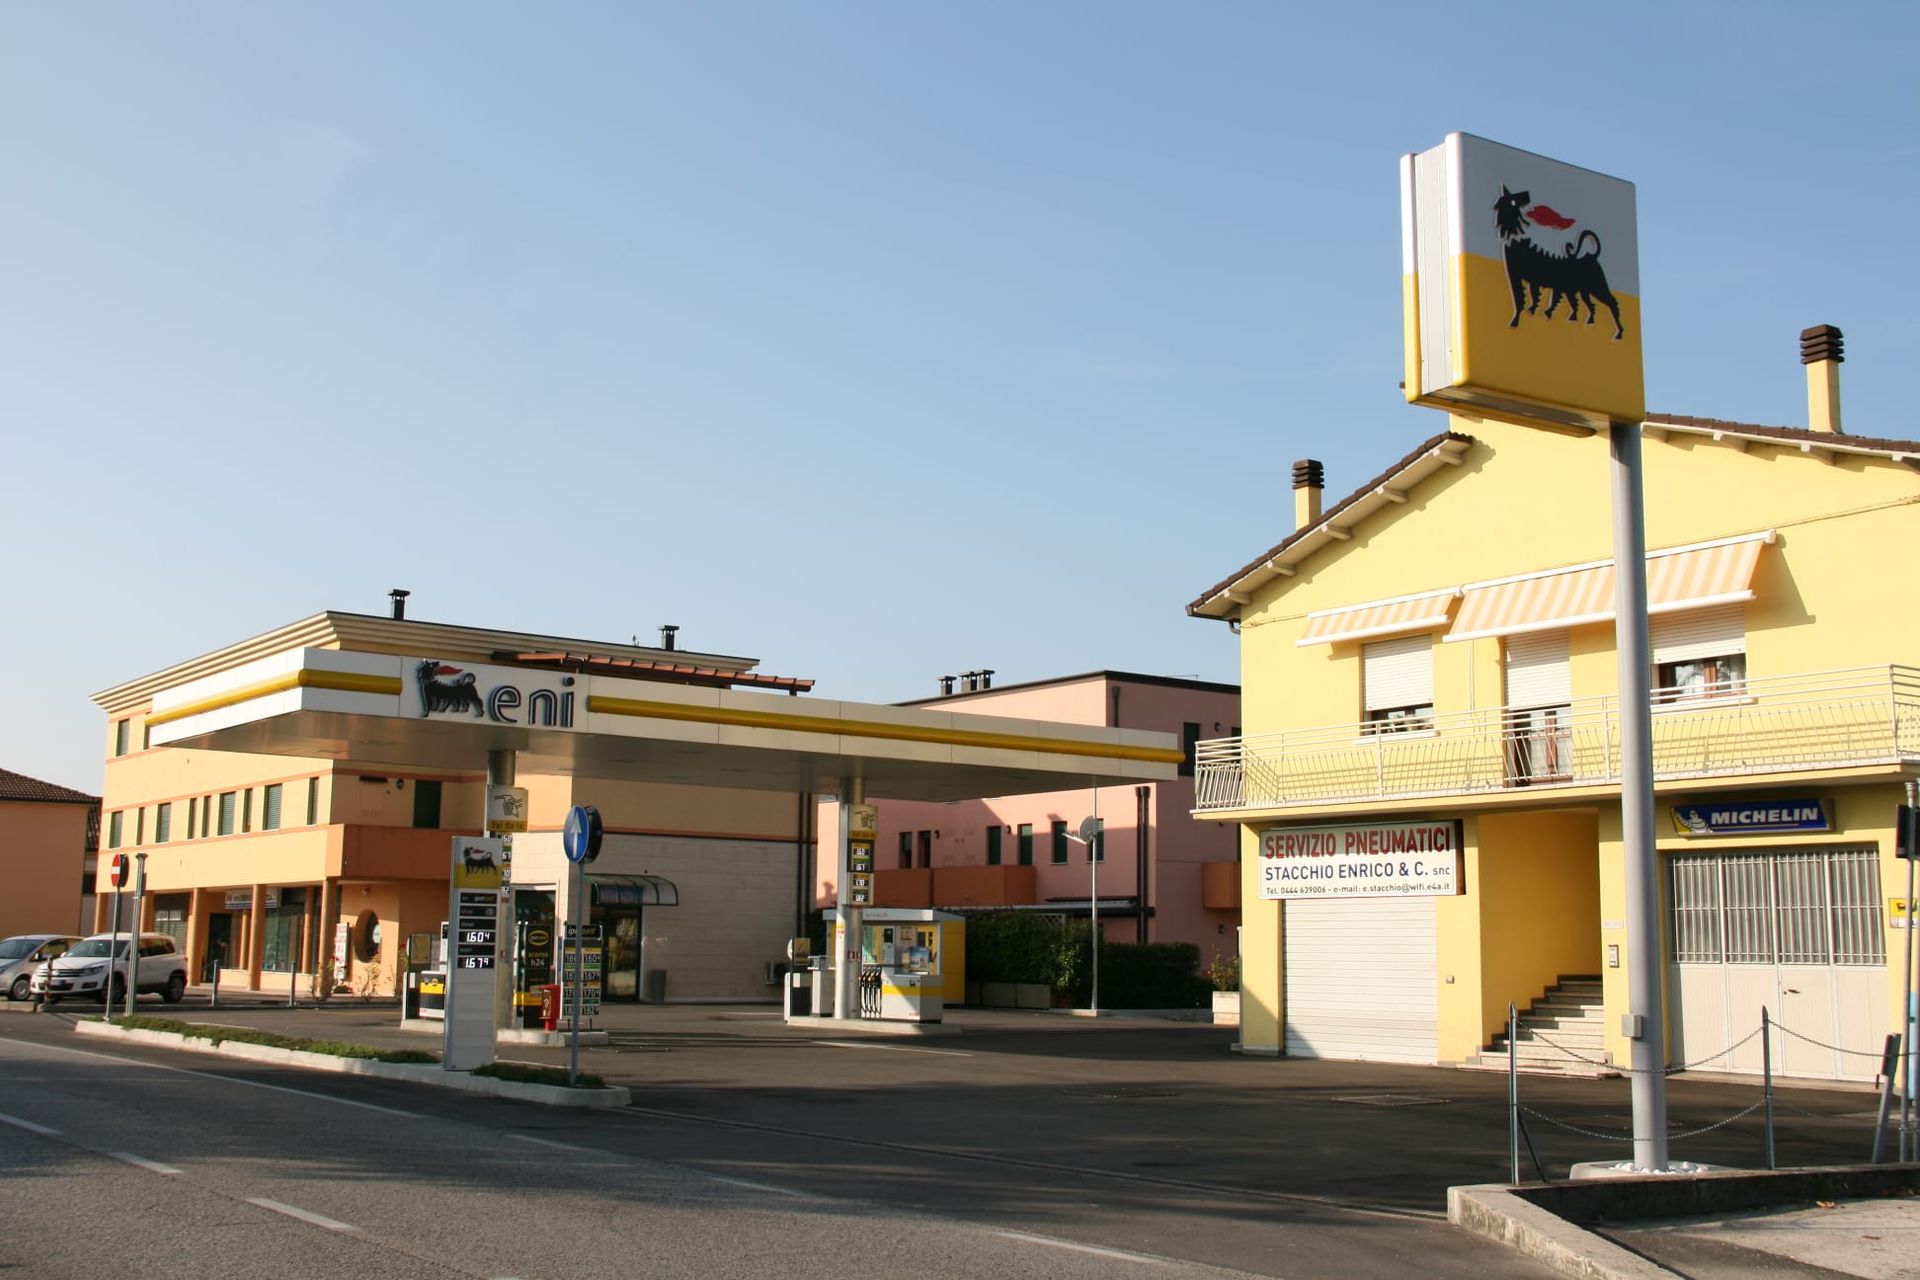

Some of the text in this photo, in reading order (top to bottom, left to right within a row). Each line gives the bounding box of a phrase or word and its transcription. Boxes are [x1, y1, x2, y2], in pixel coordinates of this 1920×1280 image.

[488, 677, 575, 728] eni
[1711, 807, 1818, 825] MICHELIN
[1265, 827, 1450, 859] SERVIZIO PNEUMATICI
[1265, 861, 1450, 881] STACCHIO ENRICO & C. snc
[1266, 887, 1278, 895] Tel.
[1281, 887, 1298, 895] 0444
[1299, 886, 1326, 894] 639006
[1333, 885, 1361, 893] e-mail:
[530, 958, 545, 967] h24
